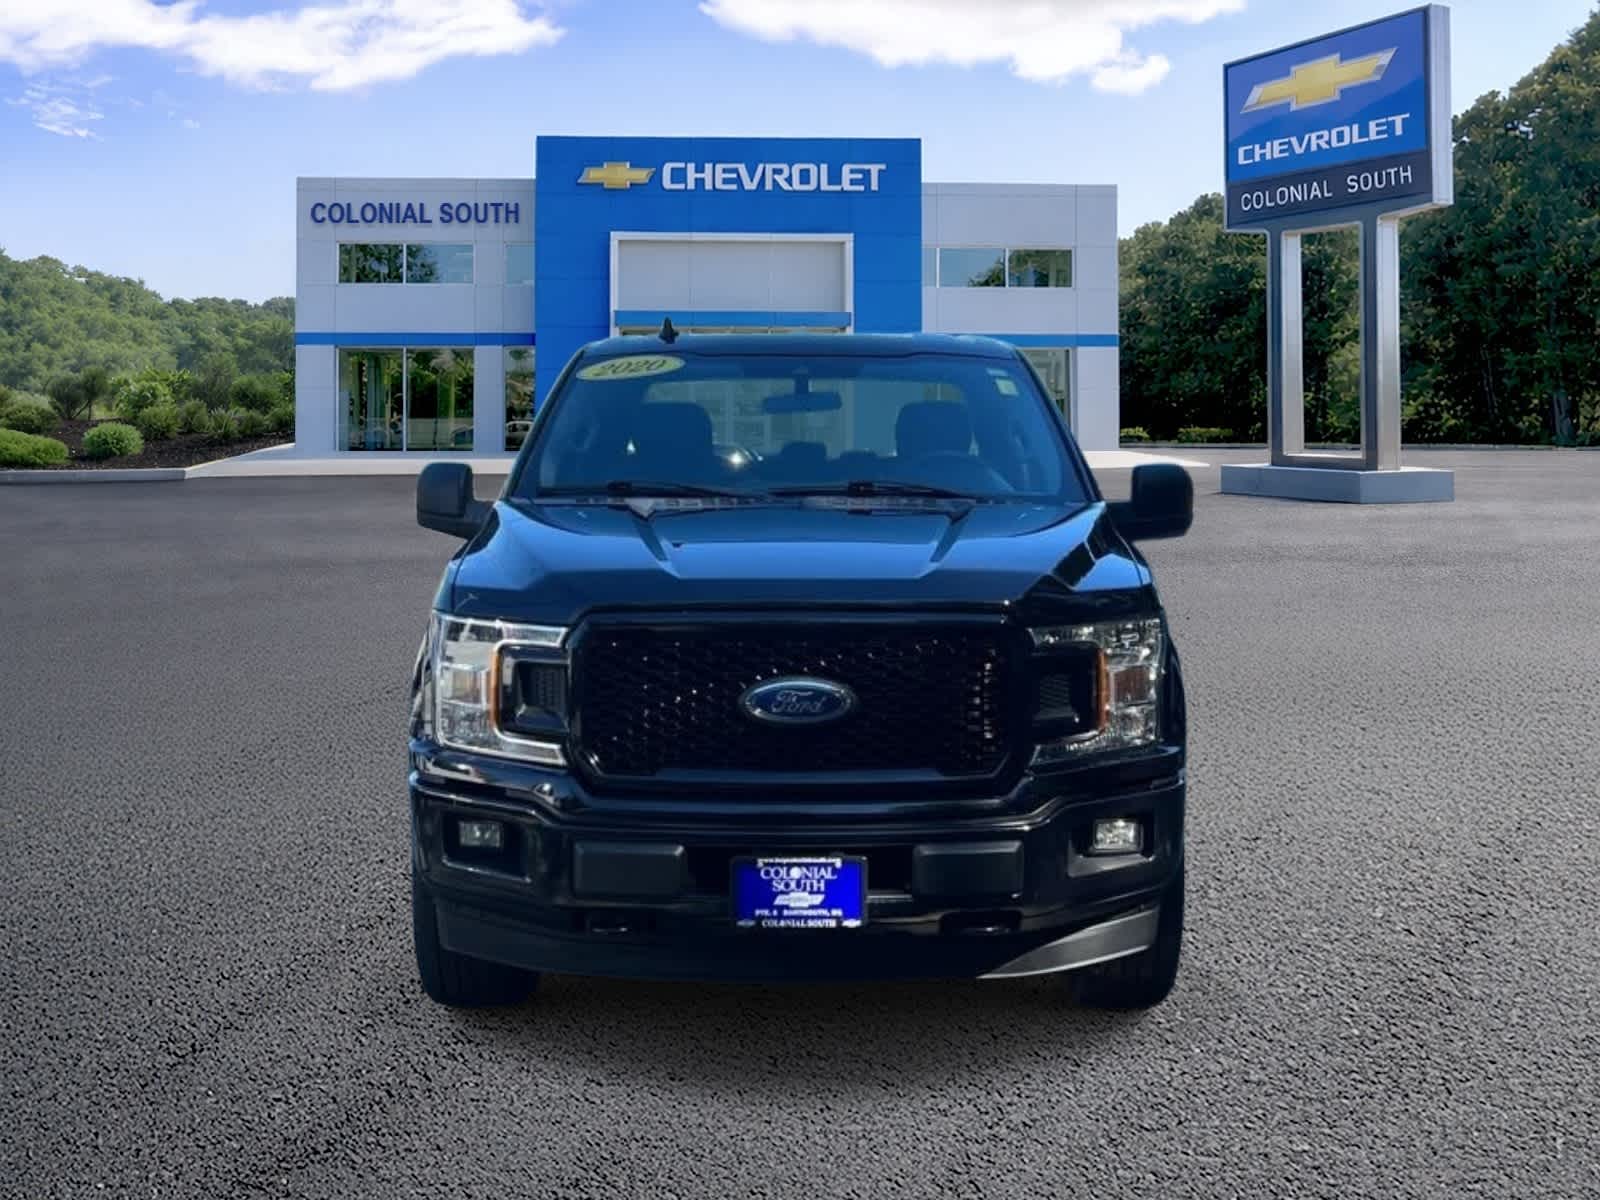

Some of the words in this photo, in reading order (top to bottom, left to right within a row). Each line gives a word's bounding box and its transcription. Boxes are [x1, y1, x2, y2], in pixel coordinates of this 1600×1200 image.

[1238, 114, 1409, 165] CHEVROLET
[662, 162, 887, 191] CHEVROLET
[1241, 181, 1333, 211] COLONIAL
[1347, 166, 1412, 193] SOUTH
[310, 202, 433, 224] COLONIAL
[439, 202, 520, 224] SOUTH
[594, 359, 668, 376] 2020
[771, 690, 825, 712] Ford
[760, 866, 838, 879] COLONIAL
[772, 880, 825, 892] SOUTH
